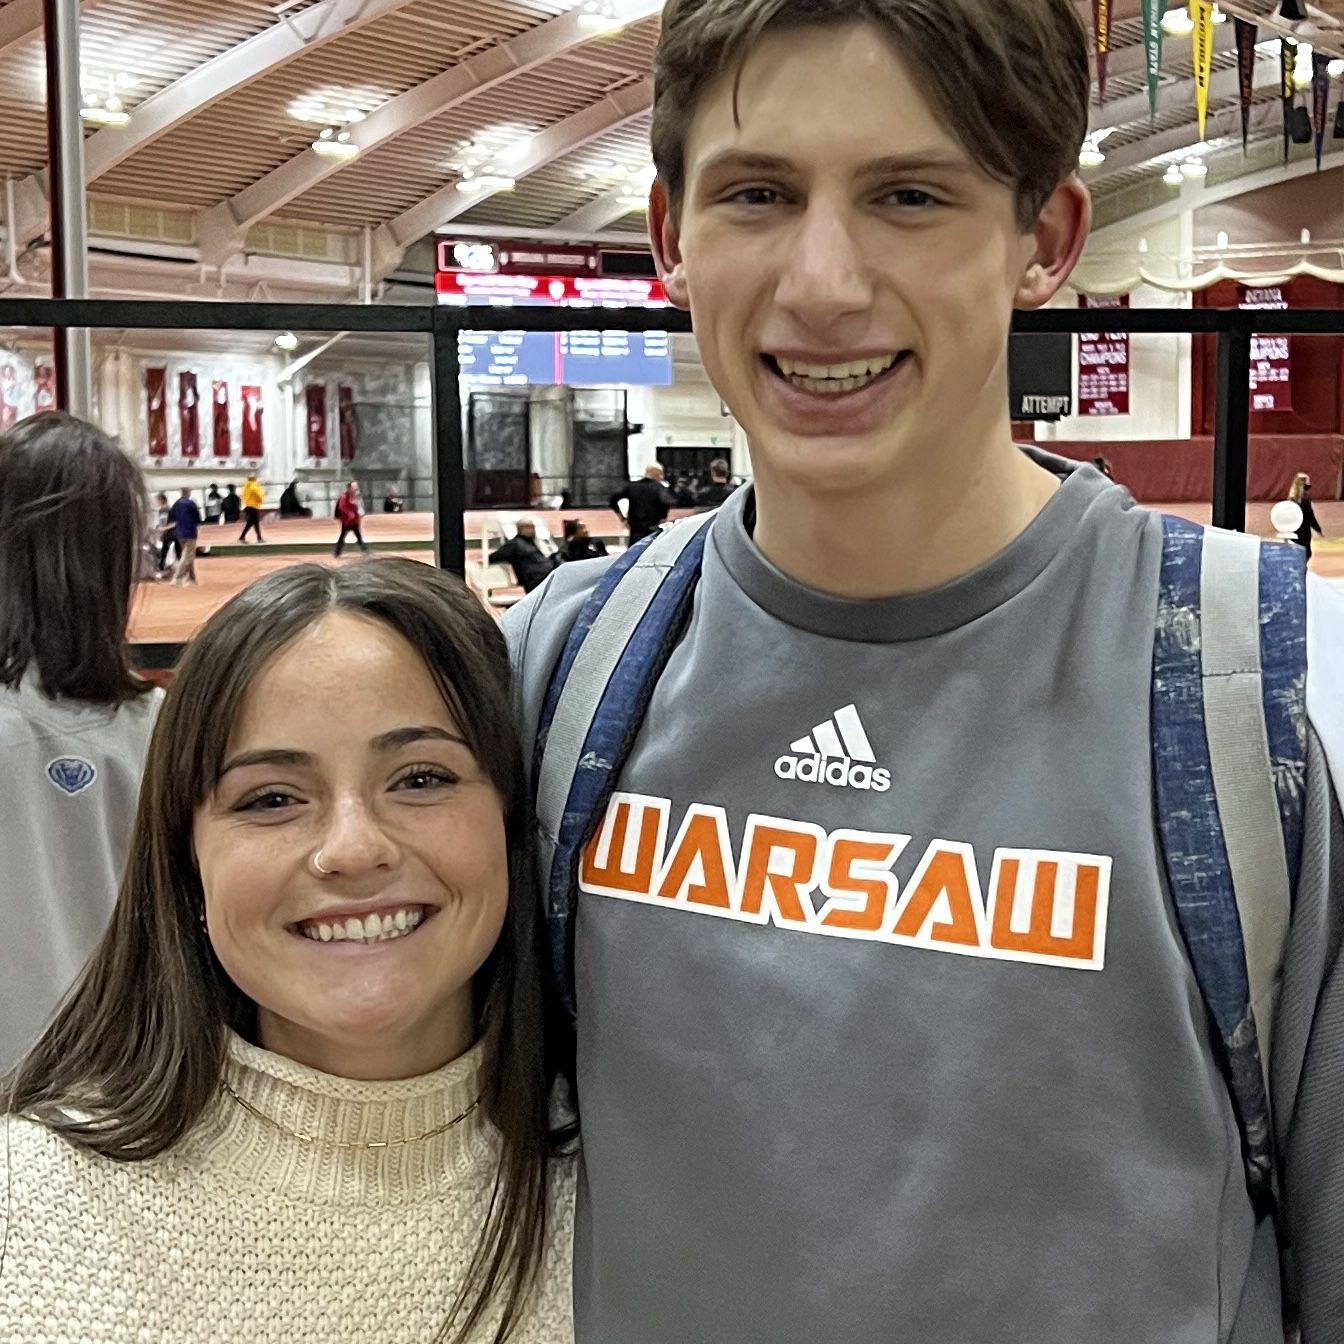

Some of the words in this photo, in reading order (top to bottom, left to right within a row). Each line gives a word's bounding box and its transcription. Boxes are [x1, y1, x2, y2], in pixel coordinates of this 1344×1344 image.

[1021, 395, 1070, 414] ATTEMPT
[773, 752, 892, 793] adidas
[578, 791, 1113, 971] WARSAW
